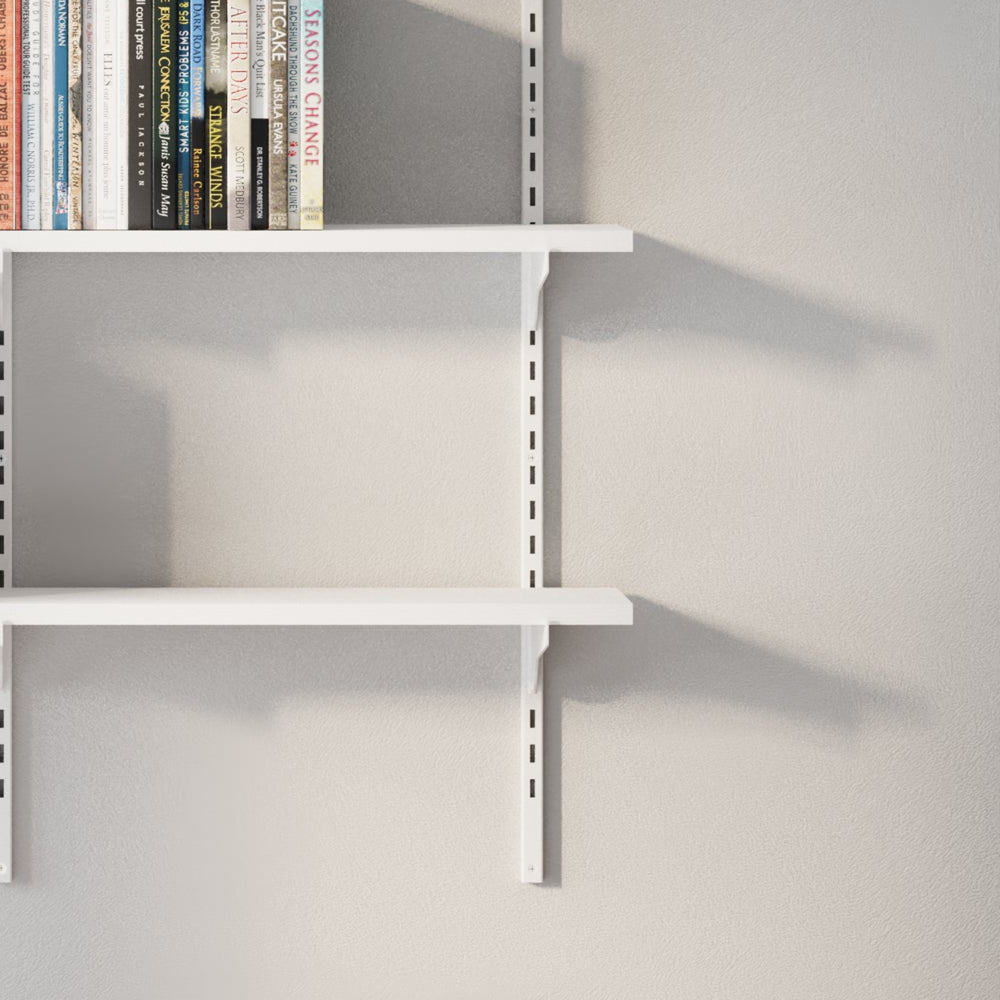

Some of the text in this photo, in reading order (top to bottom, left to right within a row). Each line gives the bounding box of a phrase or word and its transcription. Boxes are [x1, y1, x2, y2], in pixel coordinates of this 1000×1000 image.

[58, 12, 66, 46] NORMAN
[136, 6, 144, 32] court
[158, 6, 170, 53] JERUSALEM
[180, 10, 189, 25] (P5
[256, 4, 265, 28] Black
[134, 34, 144, 59] press
[180, 30, 189, 82] PROBLEMS
[193, 3, 202, 117] DARK ROAD FORWARD
[210, 26, 220, 73] LASTNAME
[231, 6, 248, 115] AFTER DAYS
[256, 31, 265, 57] Man's
[159, 57, 170, 121] CONNECTION
[254, 59, 265, 79] Quit
[256, 82, 265, 97] List
[289, 6, 297, 134] DACHSHUND THROUGH THE SNOW
[304, 9, 322, 166] SEASONS CHANGE
[180, 89, 189, 114] KIDS'
[274, 80, 283, 155] URSULA EVANS
[0, 125, 8, 137] DE
[180, 119, 189, 153] SMART
[72, 132, 80, 189] WINTERSON
[158, 136, 170, 217] Janis Susan May
[211, 105, 222, 208] STRANGE WINDS
[193, 181, 202, 215] Carlson
[235, 146, 245, 220] SCOTT MEDBURY
[289, 164, 297, 214] KATE GUINEY
